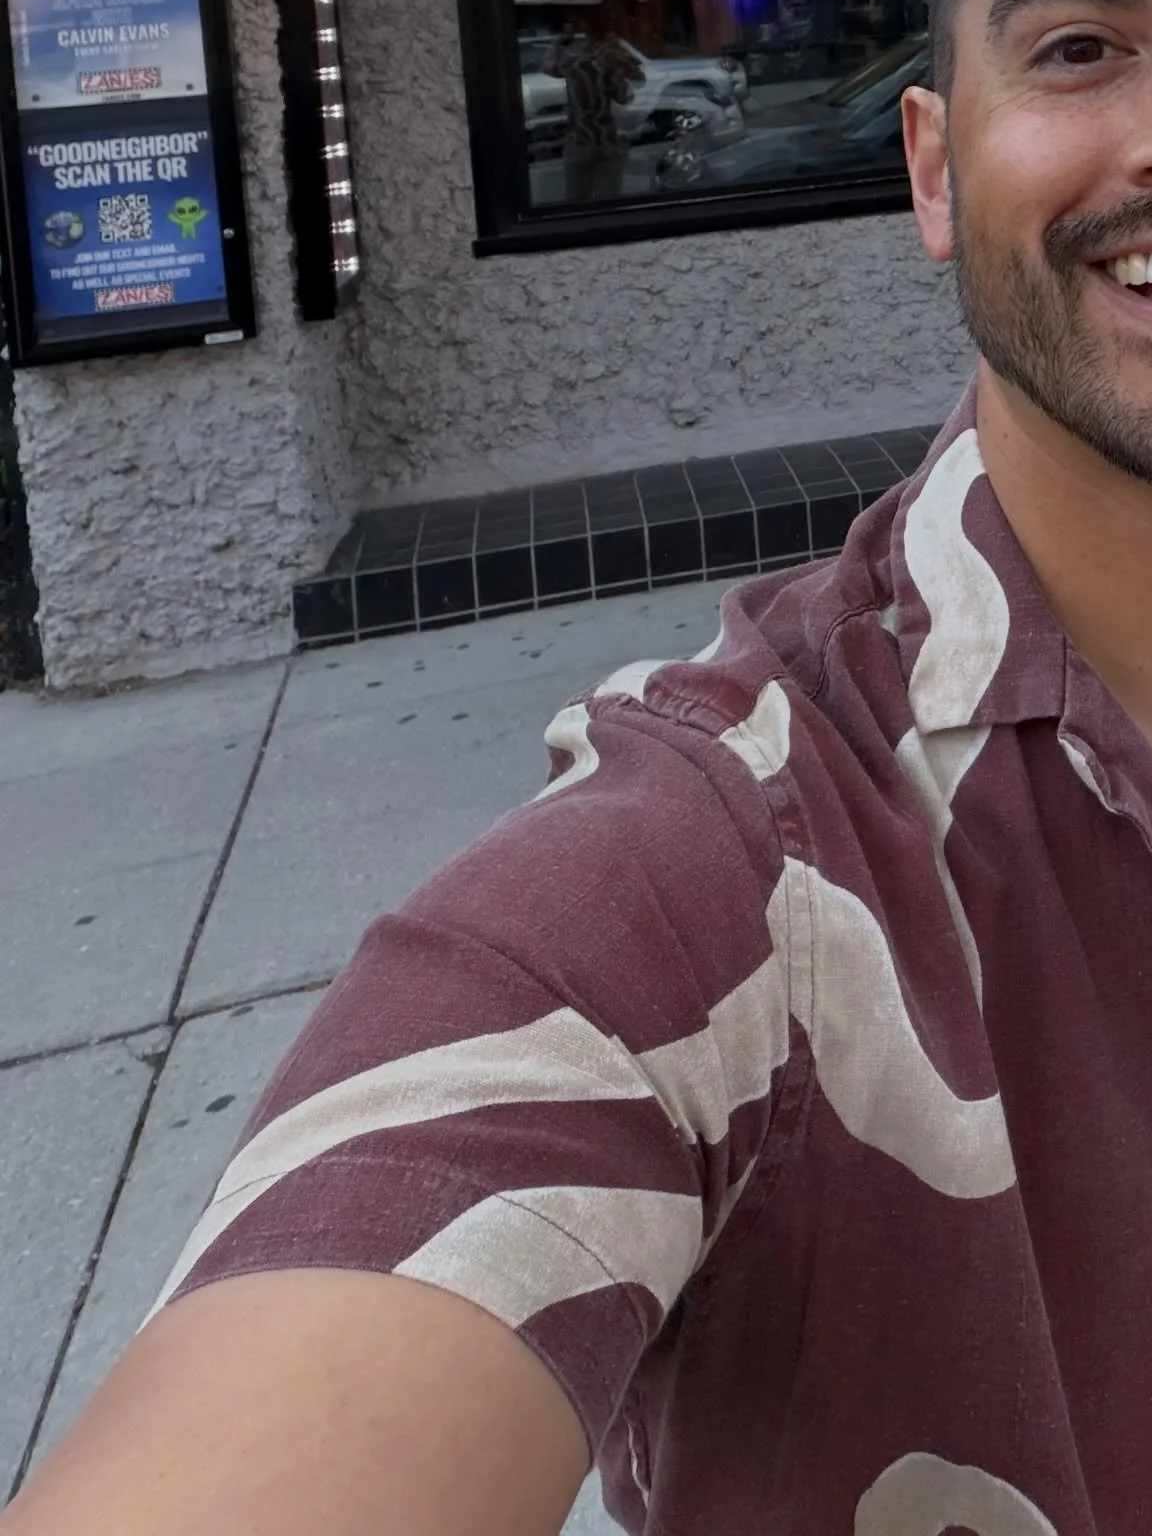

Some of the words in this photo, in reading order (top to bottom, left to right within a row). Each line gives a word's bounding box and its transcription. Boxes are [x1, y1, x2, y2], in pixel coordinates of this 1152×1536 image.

[57, 26, 114, 47] CALVIN
[119, 22, 170, 42] EVANS
[83, 69, 157, 92] ZANIES
[54, 165, 111, 190] SCAN
[114, 160, 153, 183] THE
[157, 157, 188, 182] QR
[100, 285, 170, 306] ZANIES
